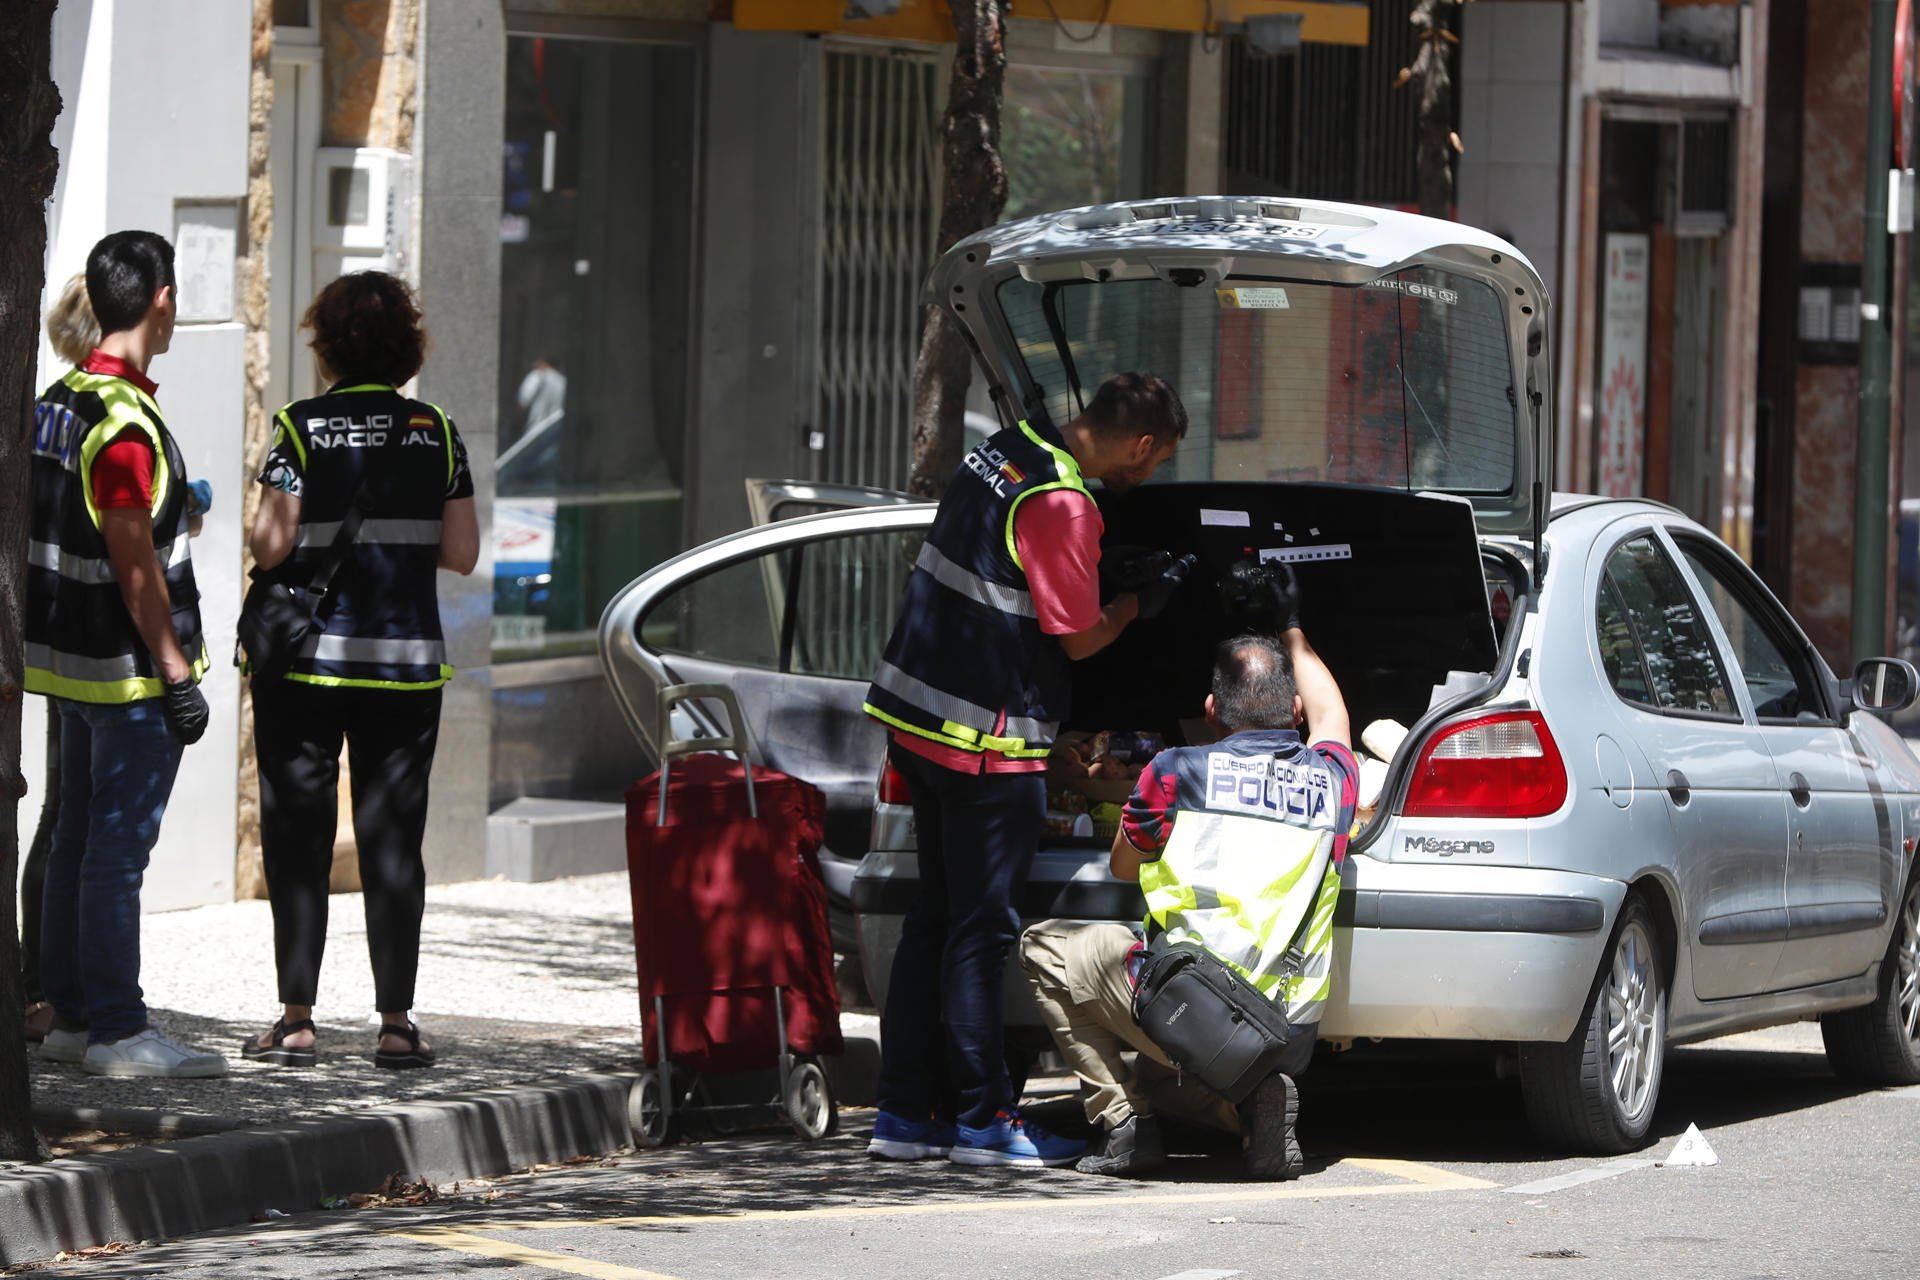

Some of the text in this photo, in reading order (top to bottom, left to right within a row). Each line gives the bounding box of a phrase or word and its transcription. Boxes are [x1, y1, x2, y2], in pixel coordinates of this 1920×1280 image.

[307, 415, 393, 432] POLICI
[310, 431, 439, 449] NACIOAL
[964, 452, 1006, 498] CIONAL
[1213, 758, 1265, 775] CUERPO
[1313, 773, 1328, 790] DE
[1211, 775, 1330, 819] POLICIA
[1684, 1139, 1694, 1151] 3
